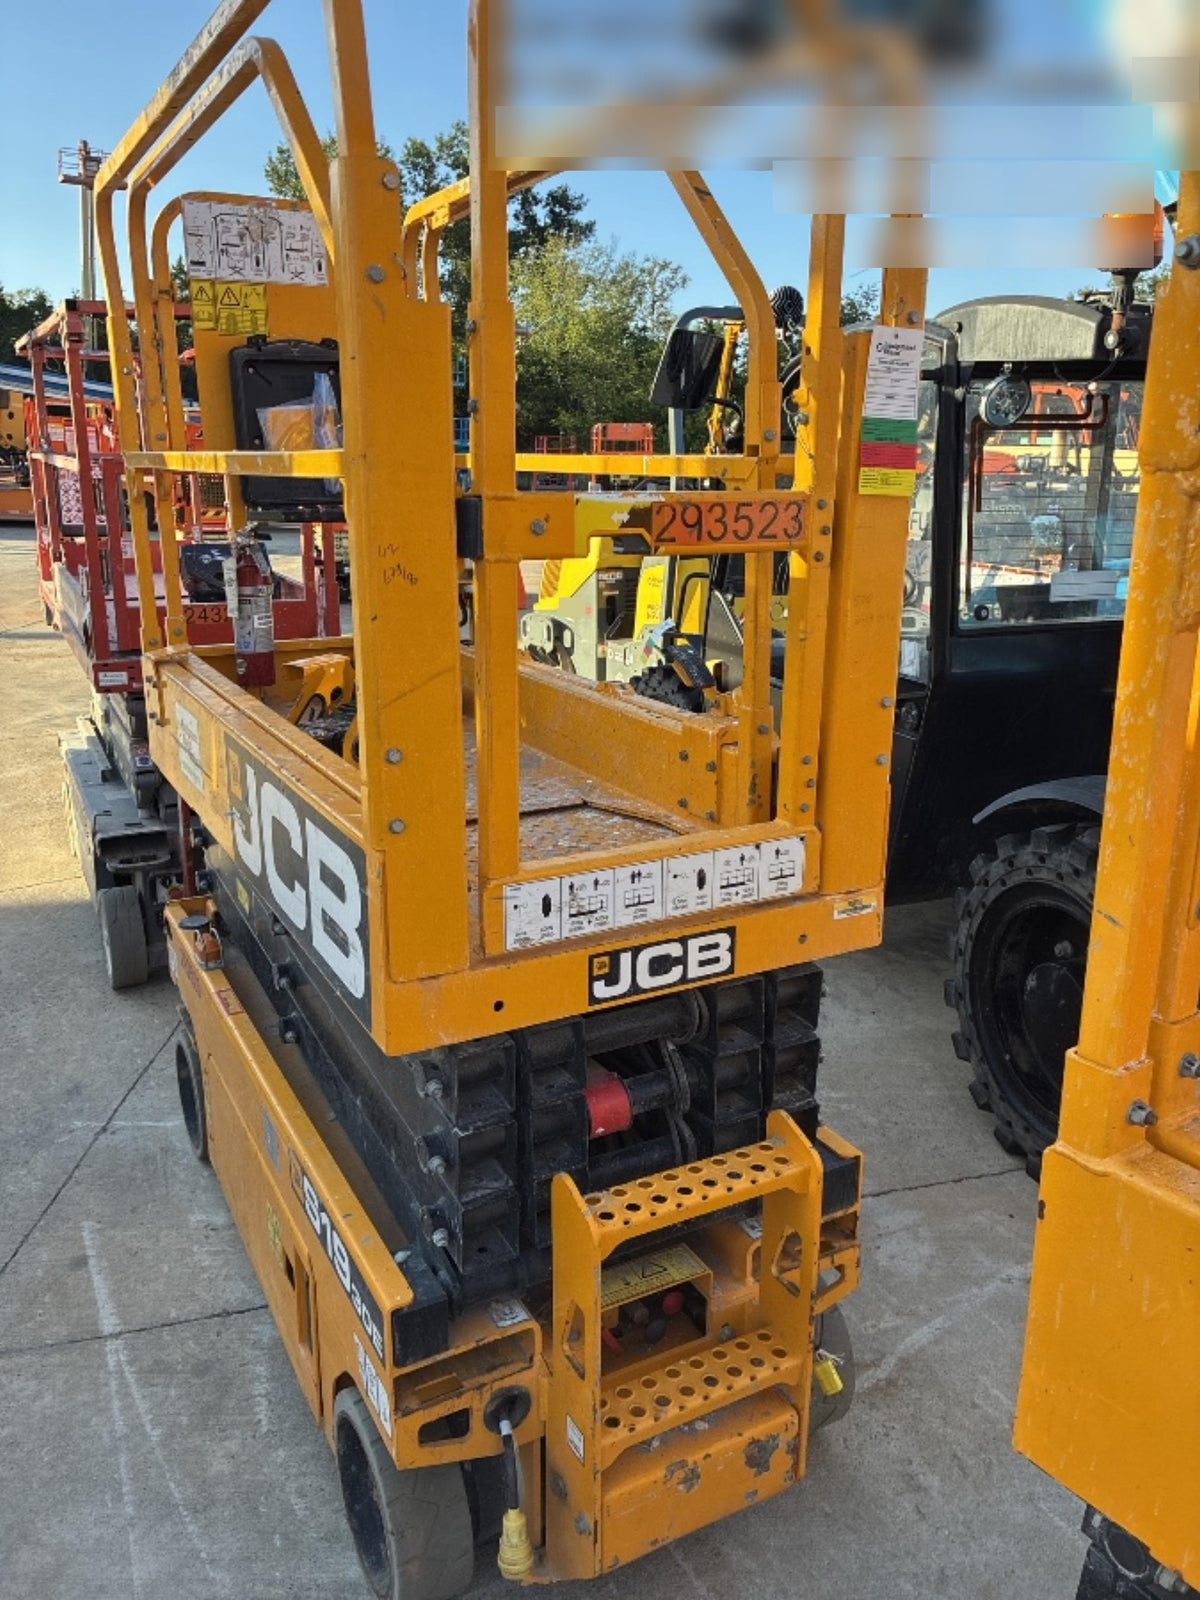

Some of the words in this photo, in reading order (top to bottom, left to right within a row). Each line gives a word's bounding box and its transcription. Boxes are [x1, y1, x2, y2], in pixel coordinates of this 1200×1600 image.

[654, 501, 803, 543] 293523
[233, 763, 365, 1000] JCB
[592, 932, 732, 999] JCB
